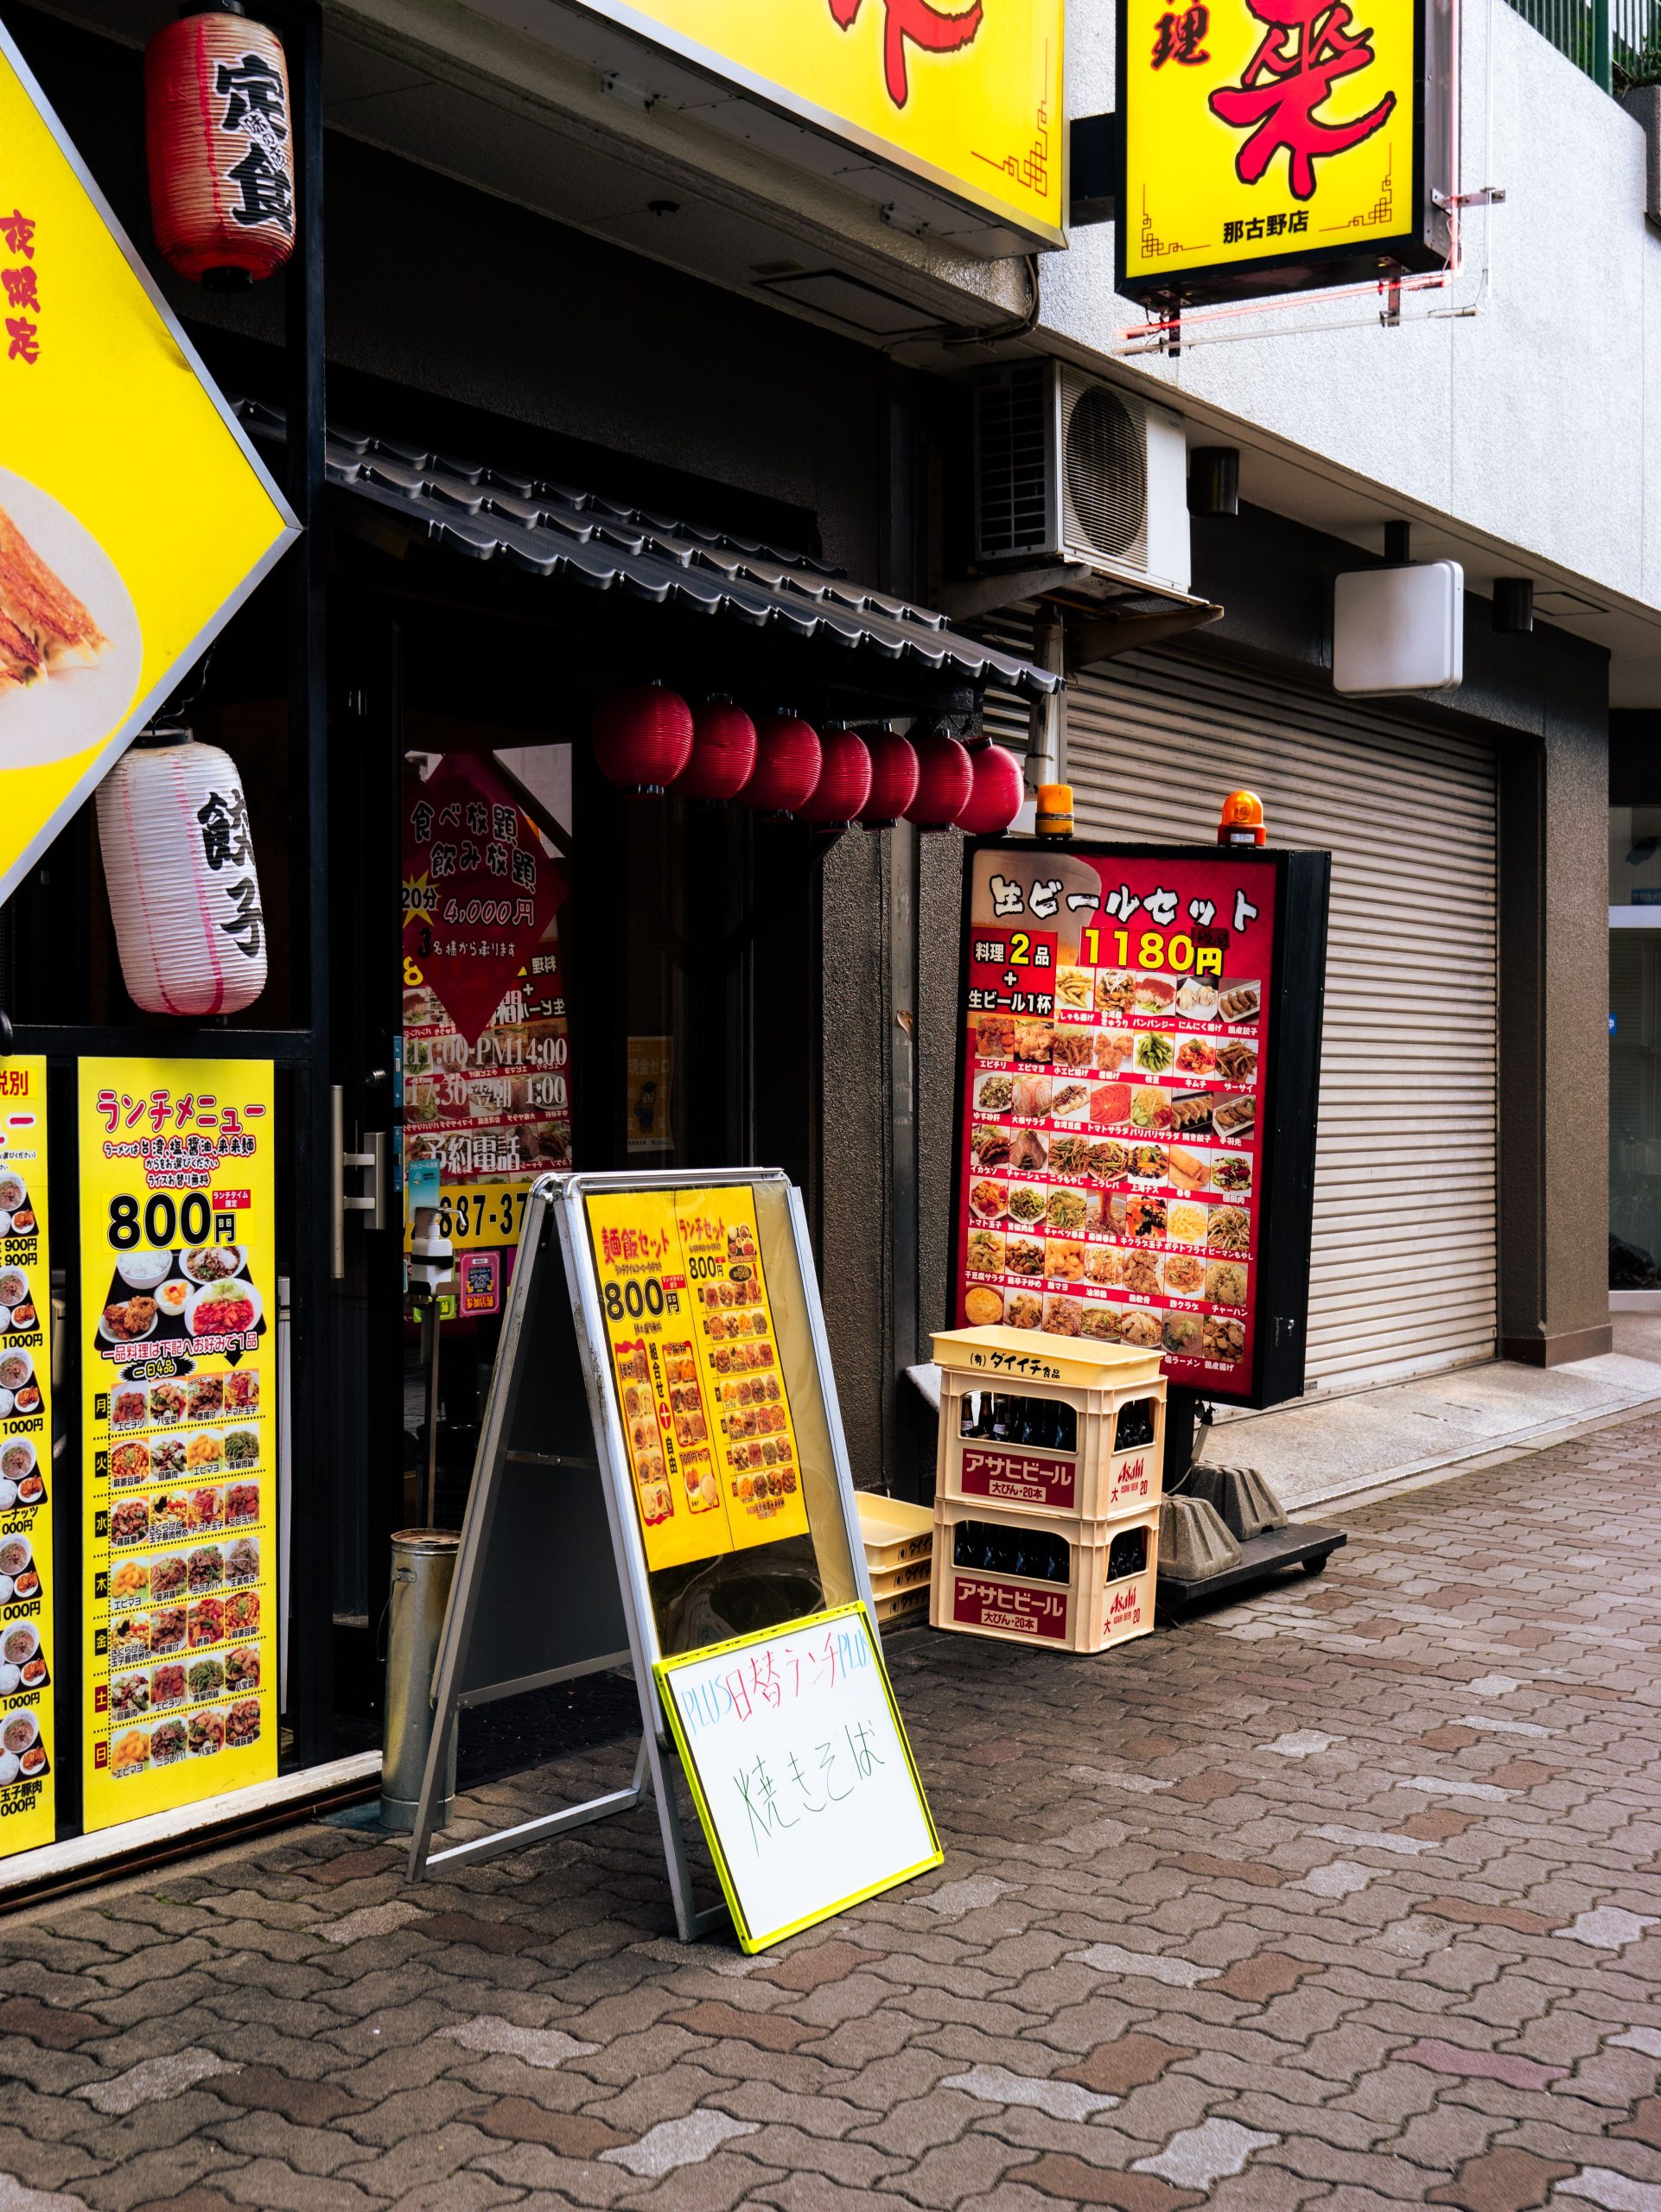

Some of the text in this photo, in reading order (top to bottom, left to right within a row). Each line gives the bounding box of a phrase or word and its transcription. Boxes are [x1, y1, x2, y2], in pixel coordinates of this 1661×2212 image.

[1150, 0, 1210, 71] 理
[215, 54, 294, 235] 定食
[1223, 210, 1309, 244] 那古野店
[1, 210, 41, 365] 夜限定
[197, 788, 264, 958] 餃子
[443, 899, 534, 926] 4,000円
[990, 874, 1258, 931] 生ビールセット
[1085, 928, 1223, 977] 1180円
[968, 989, 1053, 1016] 生ビール1杯
[979, 1059, 1007, 1070] エビチリ
[1017, 1063, 1046, 1073] エビマヨ
[1185, 1079, 1207, 1089] キムチ
[96, 1090, 266, 1135] ランチメニュー
[1087, 1122, 1130, 1136] トマトサラダ
[423, 1135, 520, 1173] 予約電話
[148, 1173, 210, 1187] ライスお替り無料
[1006, 1168, 1047, 1181] チャーシュー
[1049, 1173, 1084, 1185] ニラもやし
[213, 1192, 249, 1200] ランチタイム
[107, 1191, 236, 1251] 800円
[679, 1217, 726, 1243] ランチセット
[4, 1238, 37, 1252] 900円
[969, 1217, 1002, 1230] トマト玉子
[1164, 1243, 1206, 1255] ポテトフライ
[4, 1253, 37, 1267] 900円
[688, 1255, 724, 1280] 800円
[603, 1275, 681, 1323] 800円
[1212, 1304, 1249, 1316] チャーハン
[3, 1333, 43, 1349] 1000円
[97, 1399, 107, 1413] 月
[3, 1418, 43, 1435] 1000円
[117, 1419, 145, 1432] エビチリ
[196, 1410, 217, 1421] 唐揚げ
[226, 1405, 258, 1417] トマト玉子
[97, 1457, 107, 1471] 火
[193, 1464, 220, 1476] エビマヨ
[965, 1452, 1072, 1486] アサヒビール
[1117, 1457, 1144, 1484] Asahi
[1111, 1486, 1118, 1503] 大
[1140, 1479, 1149, 1496] 20
[96, 1516, 107, 1530] 水
[192, 1520, 225, 1534] トマト玉子
[228, 1514, 255, 1528] エビチリ
[97, 1577, 107, 1592] 木
[0, 1600, 41, 1621] 000円
[114, 1597, 142, 1611] エビマヨ
[958, 1581, 1064, 1618] アサヒビール
[1111, 1586, 1136, 1615] Asahi
[1104, 1618, 1111, 1635] 大
[1133, 1608, 1141, 1624] 20
[97, 1635, 107, 1649] 金
[159, 1643, 180, 1655] 唐揚げ
[2, 1692, 41, 1711] 1000円
[97, 1693, 107, 1707] 土
[155, 1697, 182, 1712] エビチリ
[97, 1747, 107, 1763] 日
[116, 1763, 143, 1779] エビマヨ
[733, 1719, 886, 1859] 焼きそば
